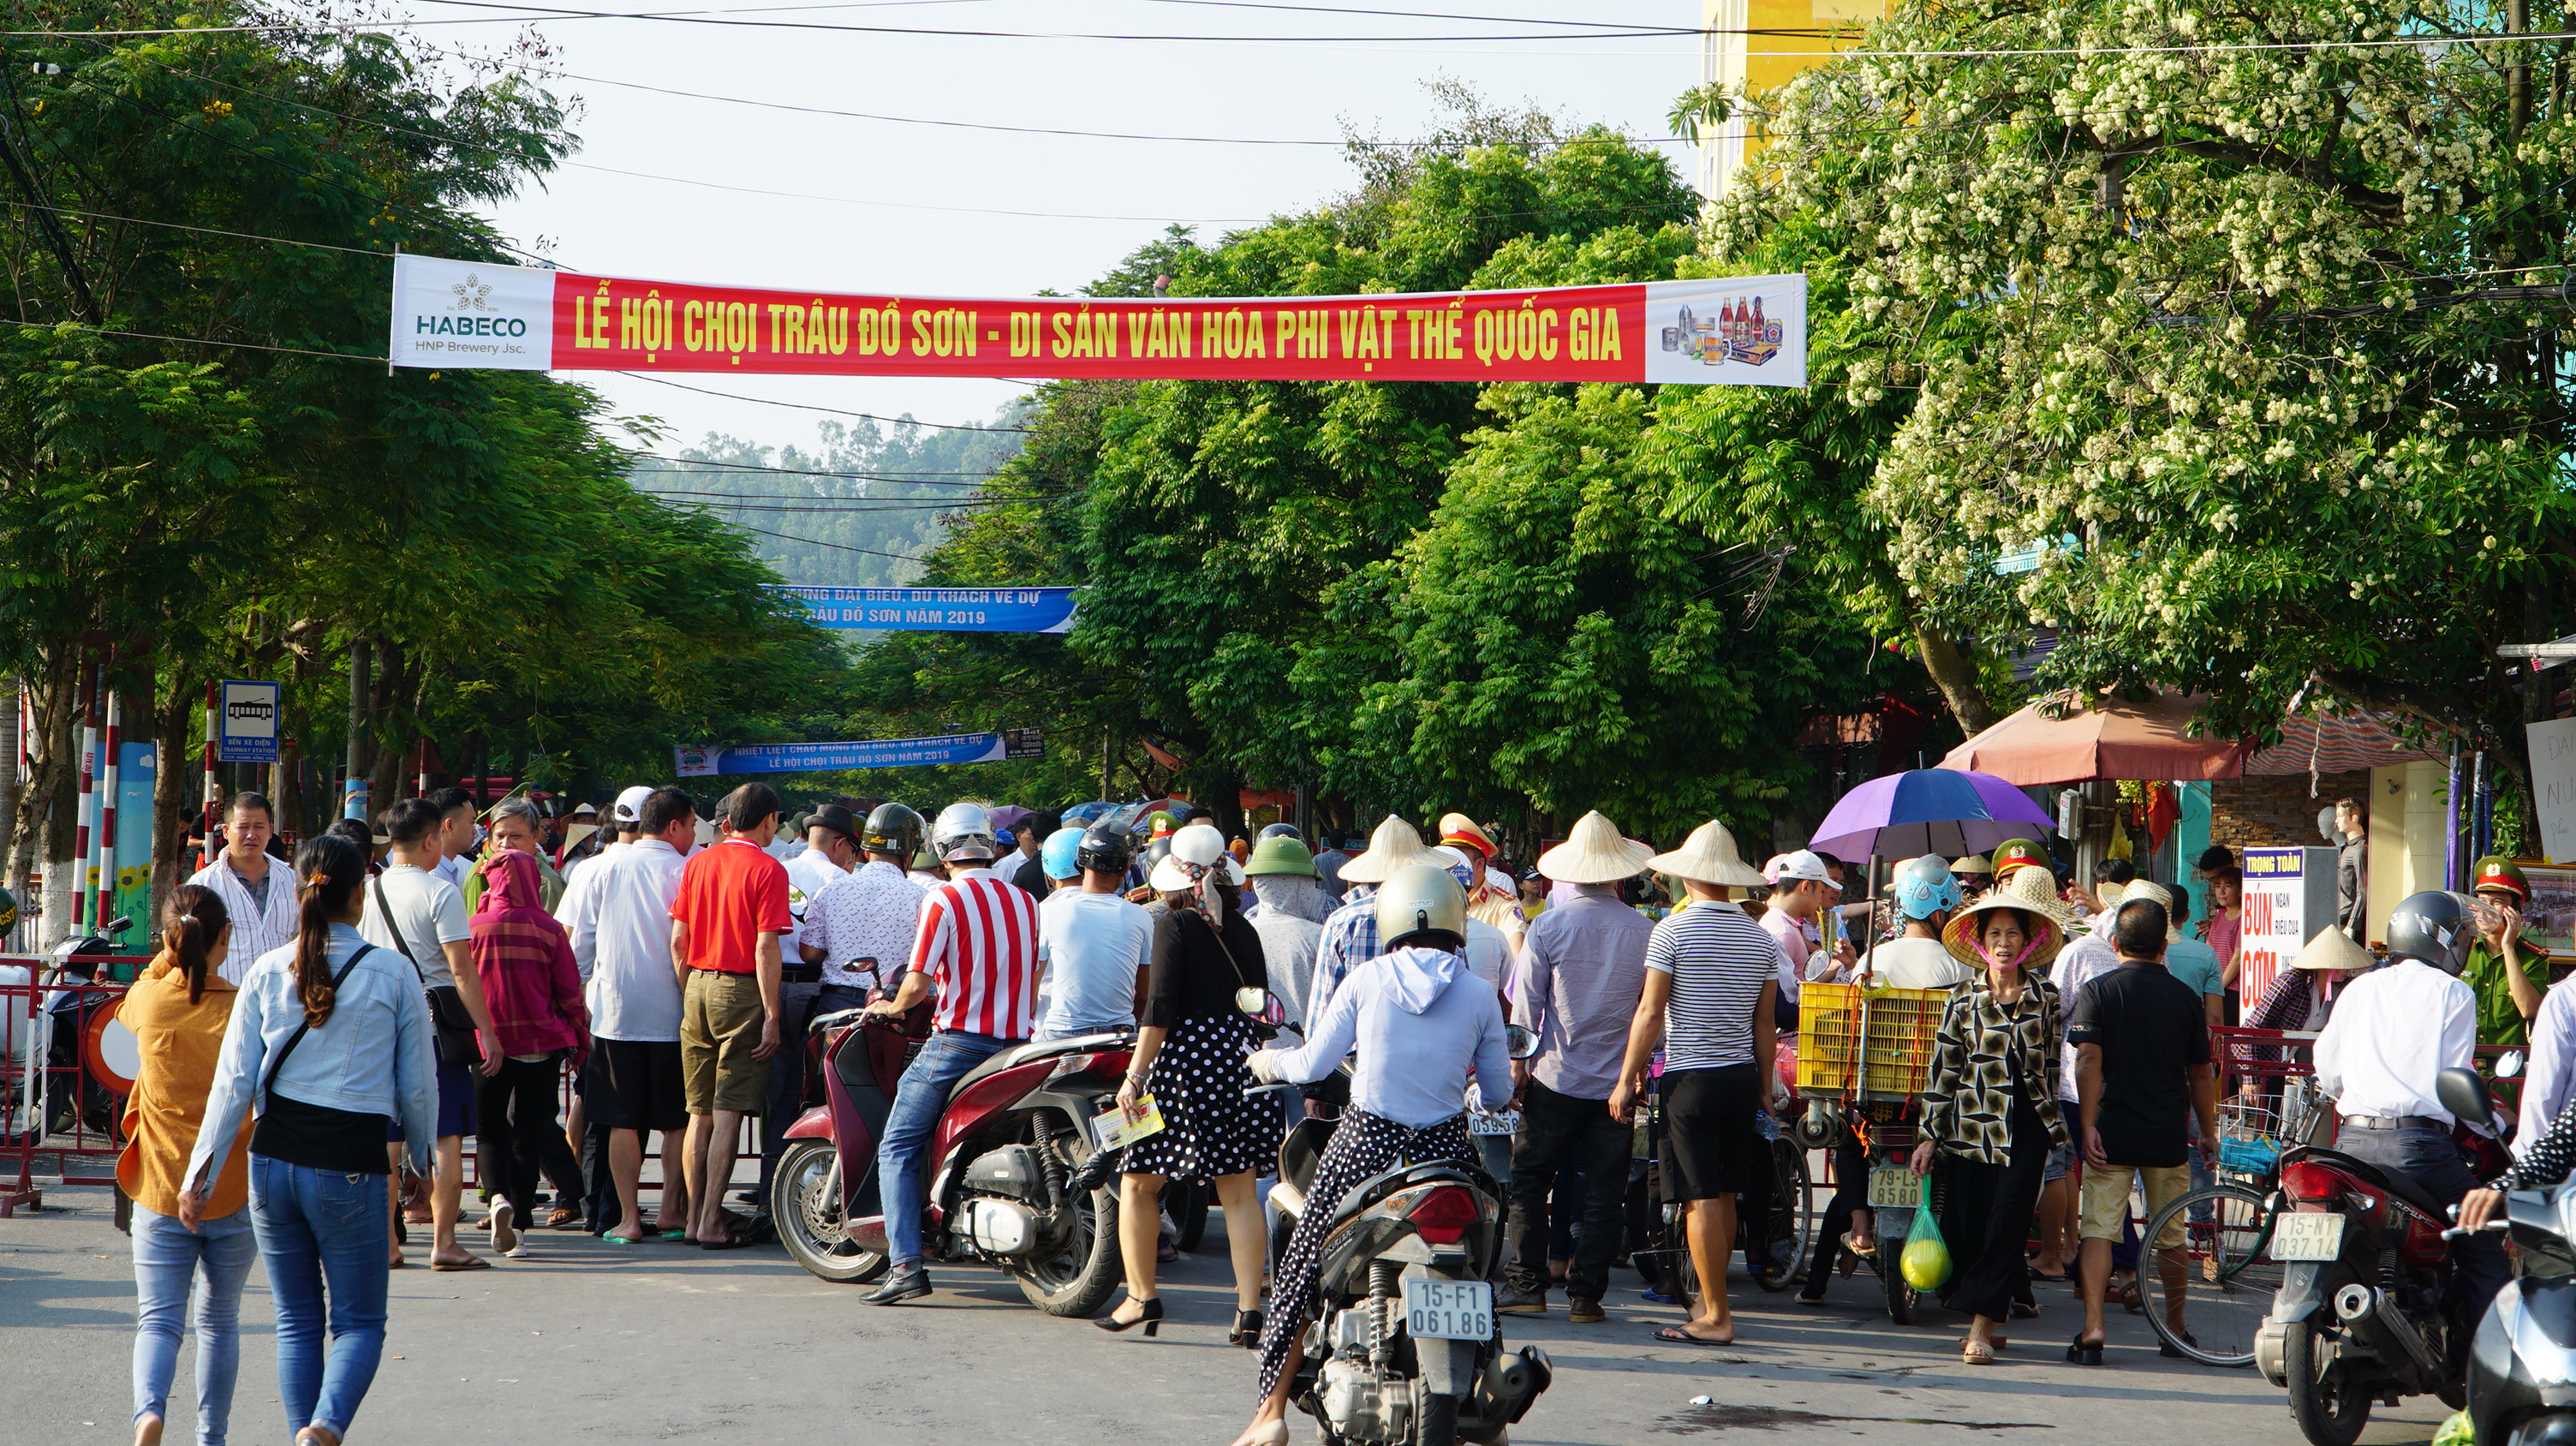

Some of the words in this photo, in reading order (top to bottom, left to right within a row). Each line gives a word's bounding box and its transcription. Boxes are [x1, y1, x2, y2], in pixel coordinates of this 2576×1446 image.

[416, 315, 527, 338] HABECO
[575, 279, 611, 349] LỄ
[621, 290, 673, 363] HỘI
[684, 300, 757, 365] CHỌI
[767, 298, 849, 356] TRÂU
[858, 297, 901, 356] ĐỒ
[911, 308, 977, 357] SƠN
[987, 331, 999, 340] -
[1010, 312, 1041, 357] DI
[1052, 302, 1118, 358] SẢN
[1128, 307, 1191, 358] VĂN
[1202, 307, 1266, 359] HÓA
[1276, 310, 1328, 359] PHI
[1339, 304, 1398, 372] VẬT
[1406, 296, 1464, 360] THỂ
[1475, 295, 1559, 367] QUỐC
[1570, 307, 1622, 361] GIA
[415, 341, 444, 351] HNP
[448, 343, 499, 356] Brewery
[503, 344, 526, 354] Jsc.
[834, 589, 861, 603] ĐẠI
[911, 591, 932, 602] DU
[1018, 590, 1041, 606] DỰ
[843, 605, 863, 622] ĐỒ
[868, 608, 901, 623] SƠN
[906, 607, 942, 624] NĂM
[947, 611, 986, 624] 2019
[784, 756, 801, 769] HỘI
[803, 756, 827, 769] CHỌI
[874, 752, 896, 763] SƠN
[899, 751, 922, 762] NĂM
[925, 750, 950, 760] 2019
[2246, 856, 2275, 876] TRỌNG
[2276, 852, 2300, 872] TOÀN
[2244, 882, 2272, 935] BÚN
[2275, 893, 2290, 908] NGAN
[2288, 920, 2299, 935] CUA
[2242, 947, 2276, 1008] CƠM
[1879, 1170, 1918, 1186] 79-L3
[1876, 1188, 1917, 1205] 8580
[2289, 1217, 2333, 1235] 15-N1
[2278, 1238, 2334, 1257] 037.14
[1422, 1284, 1477, 1310] 15-F1
[1413, 1309, 1487, 1335] 061.86
